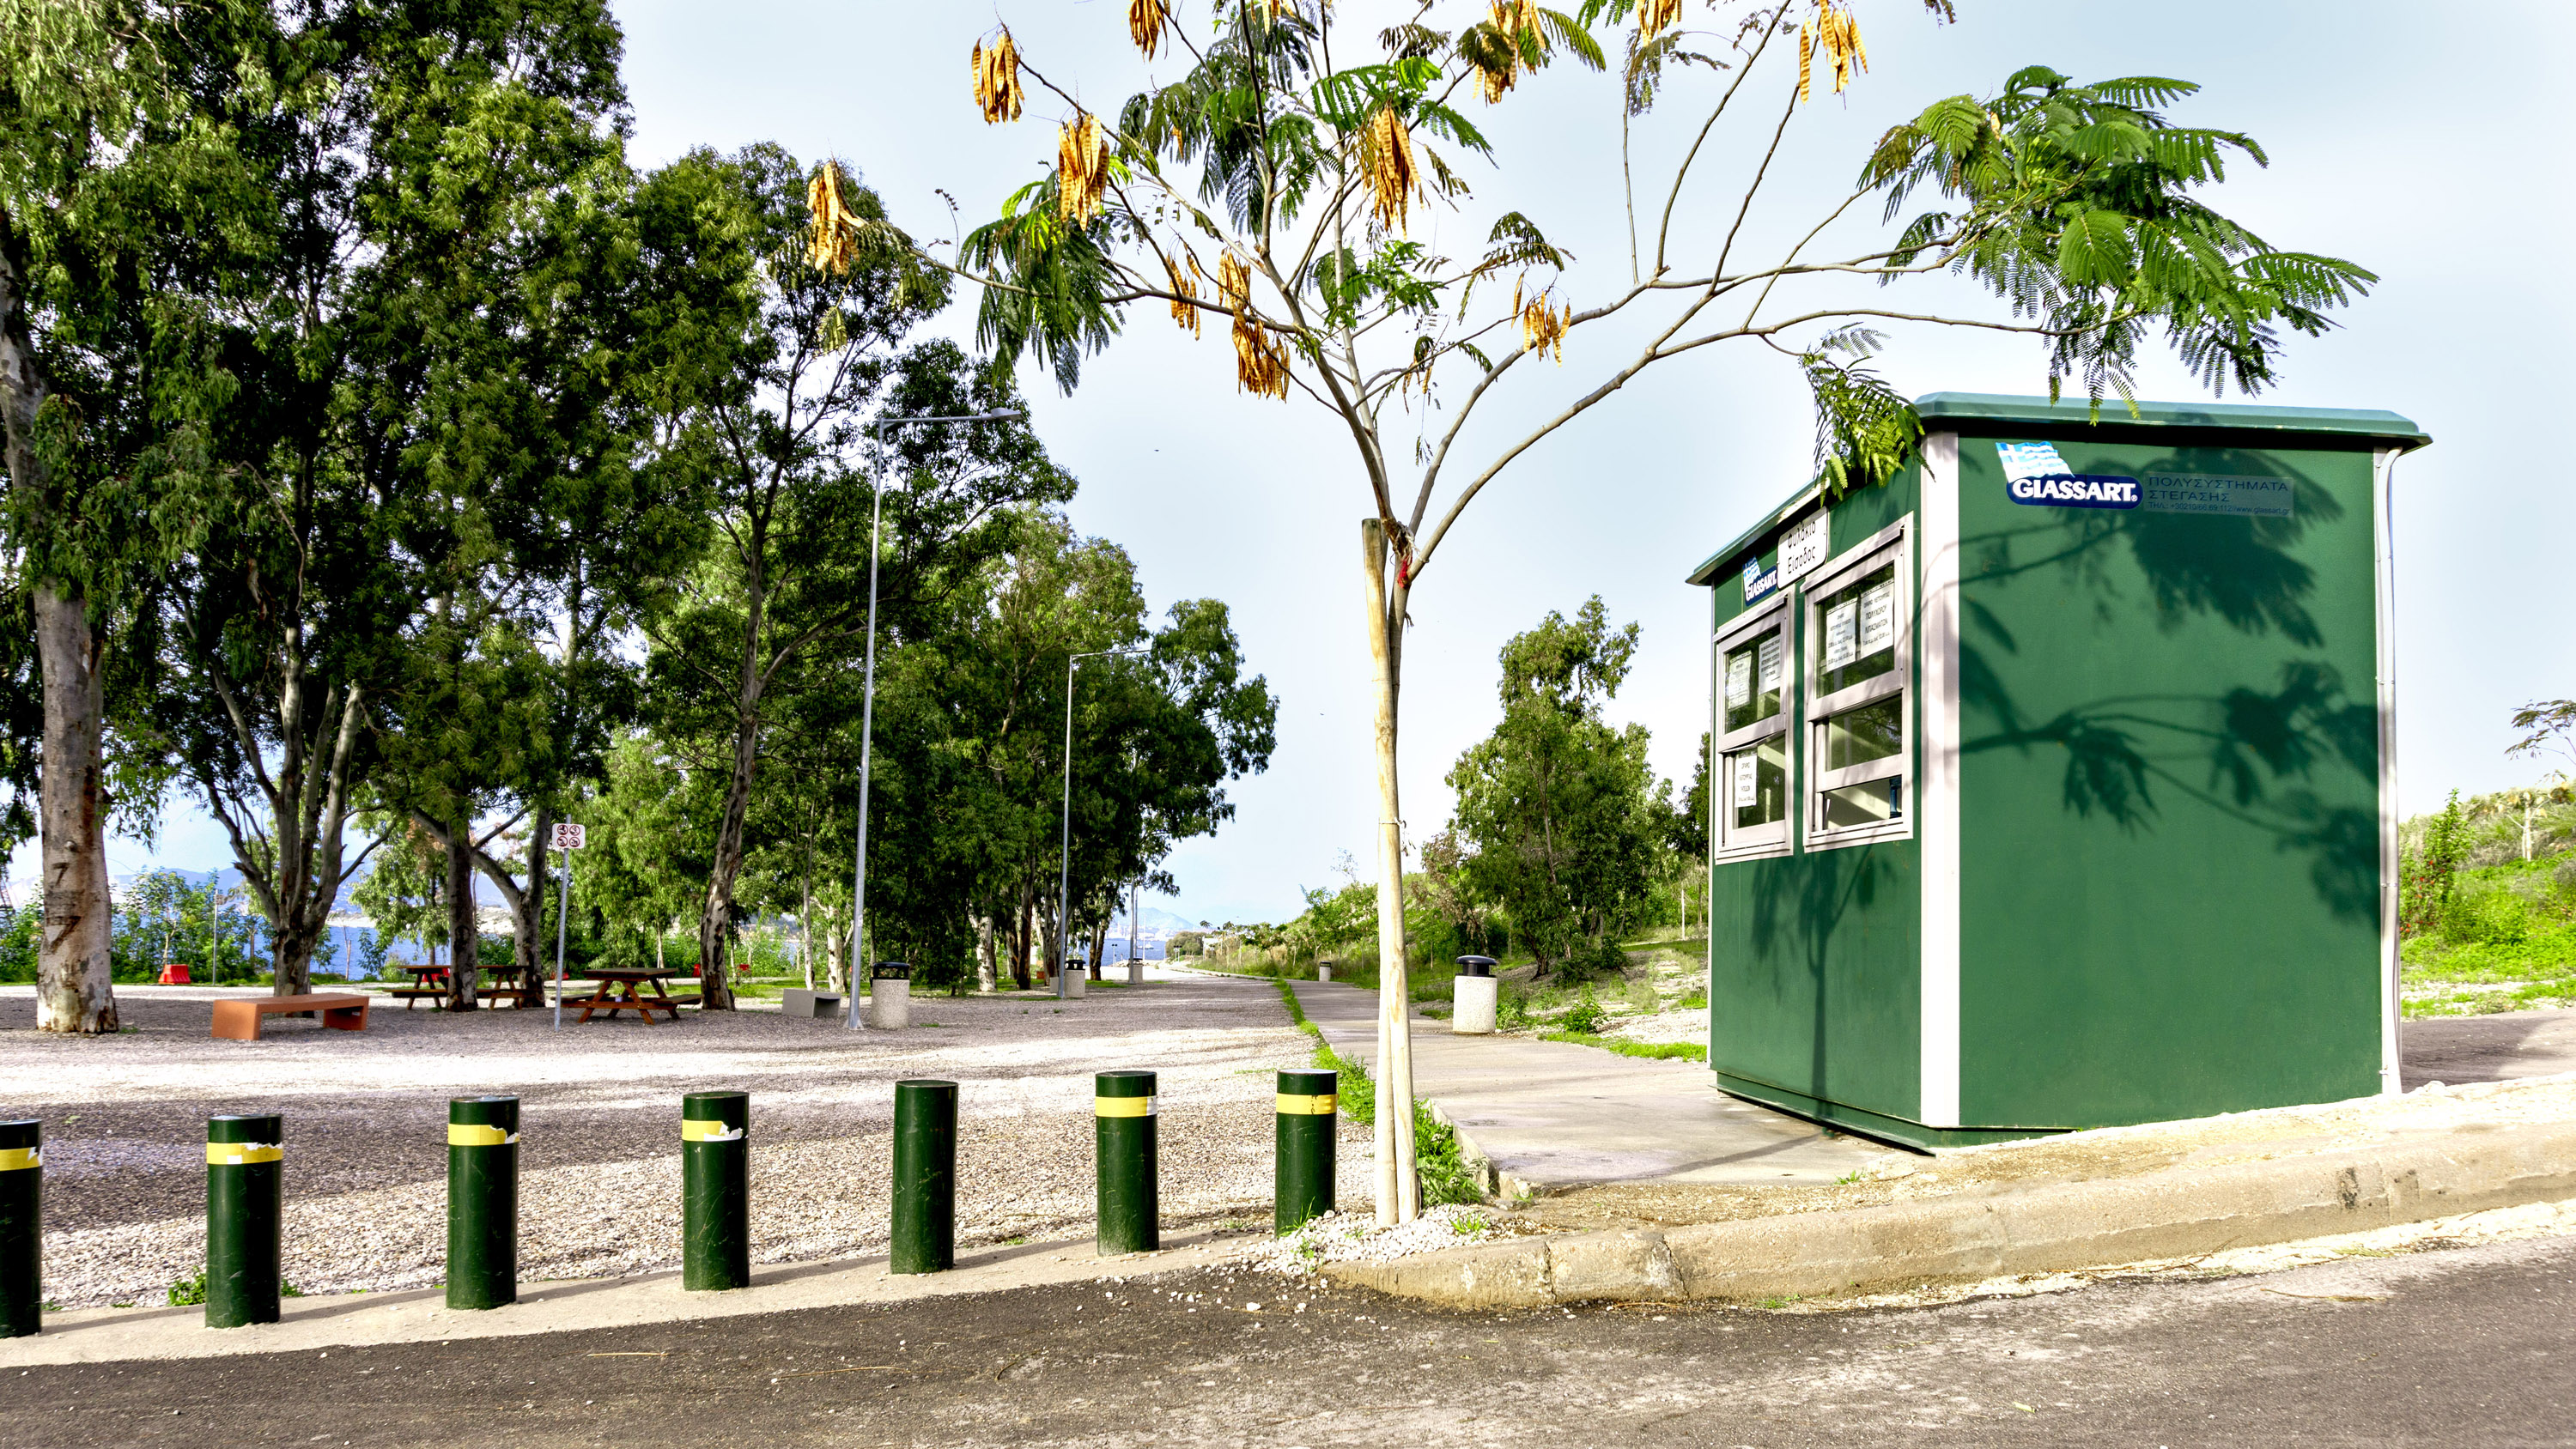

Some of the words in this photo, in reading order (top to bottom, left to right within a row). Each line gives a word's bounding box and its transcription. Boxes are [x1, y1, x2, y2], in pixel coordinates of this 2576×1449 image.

[2012, 478, 2136, 502] GLASSART
[2149, 476, 2288, 491] ΠΟΛΥΣΥΣΤΗΜΑΤΑ
[2149, 489, 2229, 502] ΣΤΕΓΑΣΗΣ
[1788, 520, 1816, 549] Φυλάκιο
[1788, 546, 1816, 574] Είσοδος
[1746, 570, 1777, 601] GLASSART
